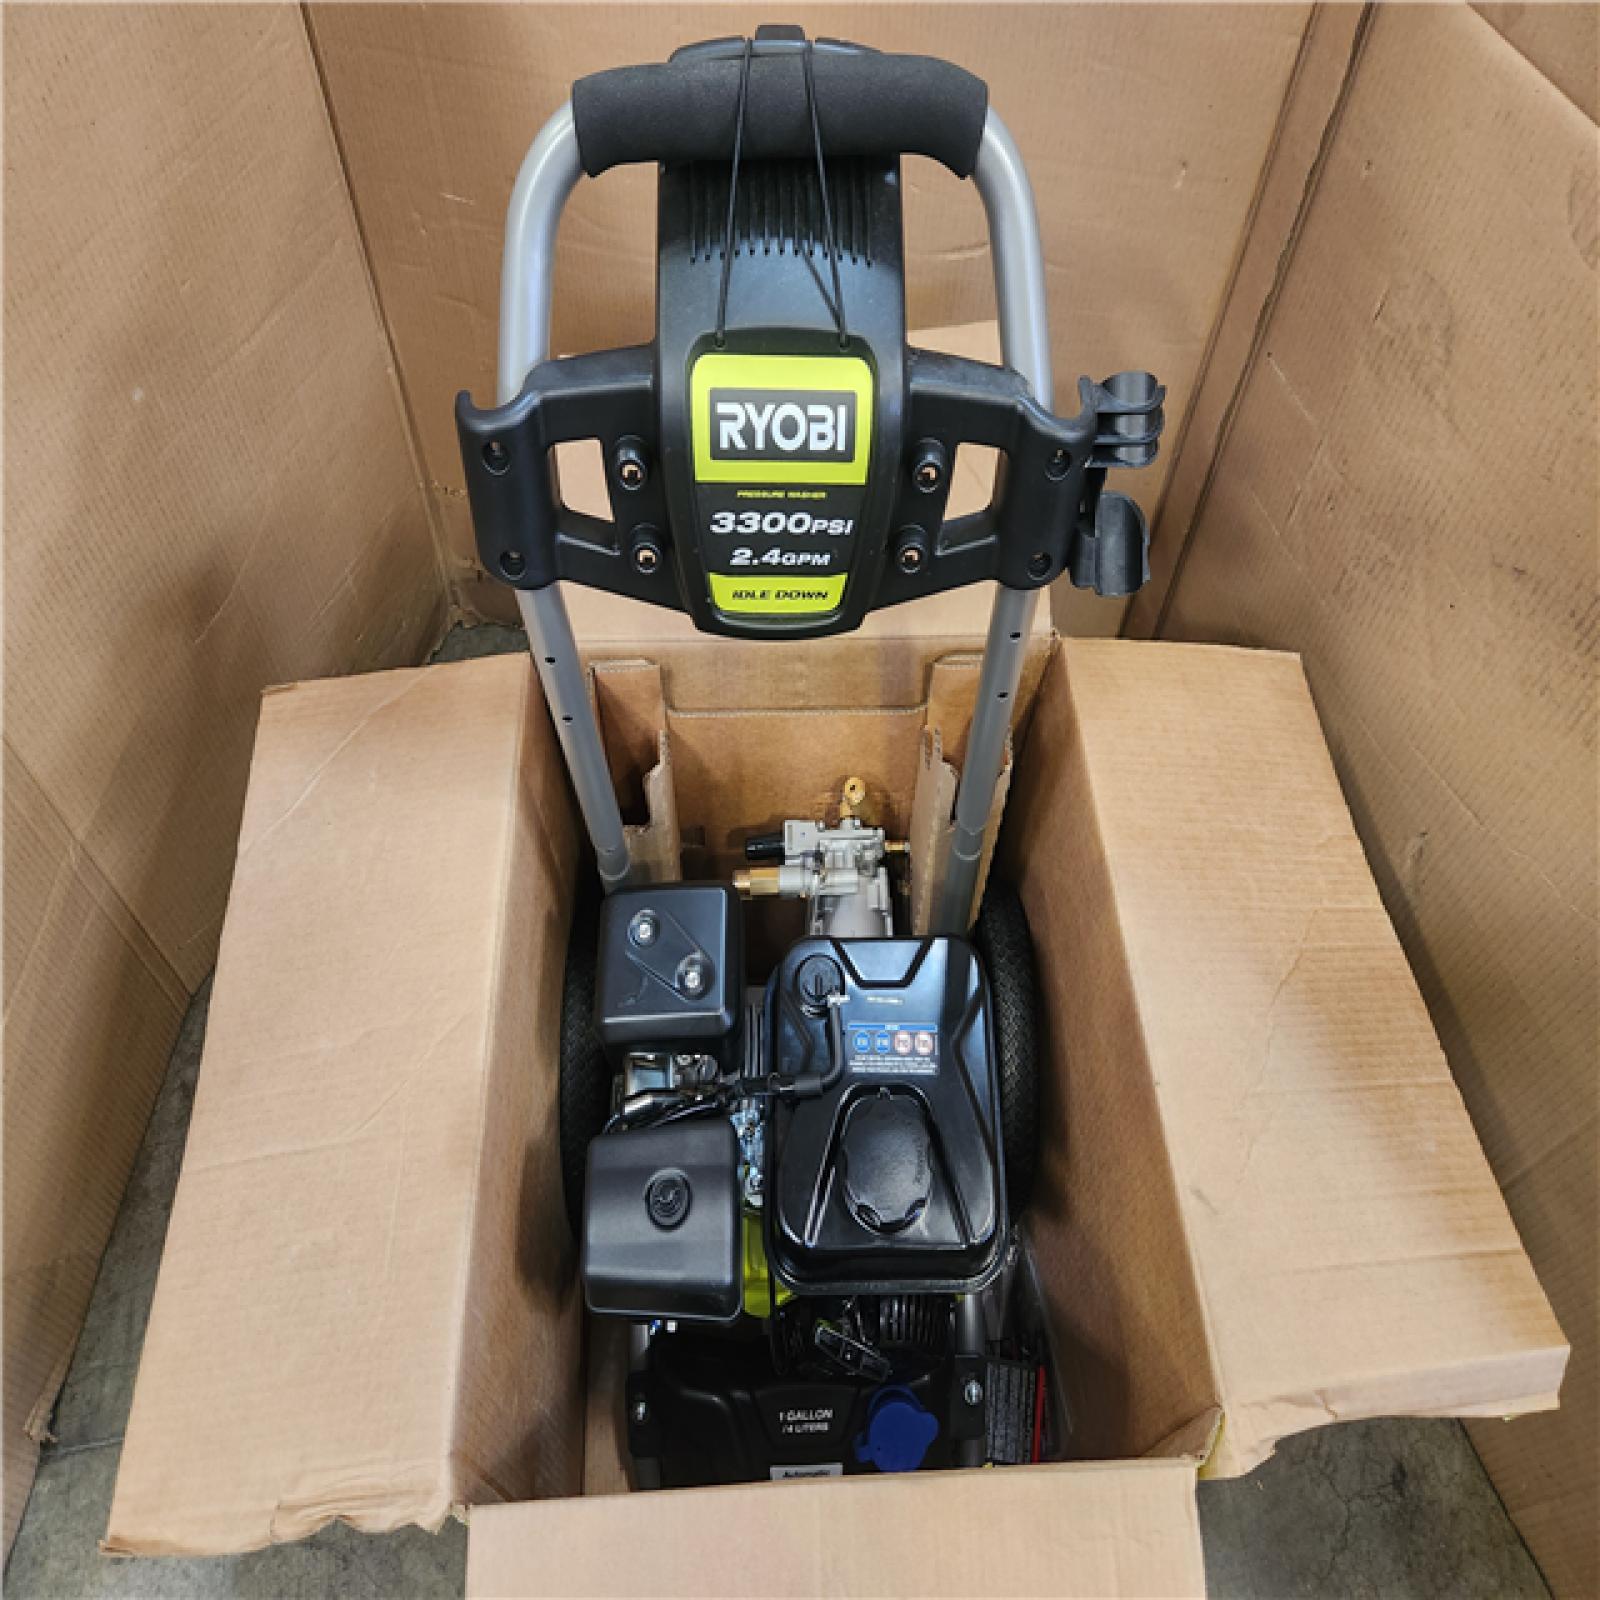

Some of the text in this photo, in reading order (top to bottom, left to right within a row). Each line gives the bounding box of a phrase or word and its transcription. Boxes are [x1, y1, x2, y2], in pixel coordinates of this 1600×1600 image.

[715, 402, 848, 452] RYOBI
[732, 589, 829, 600] IDLE DOWN
[787, 1408, 833, 1421] GALLON
